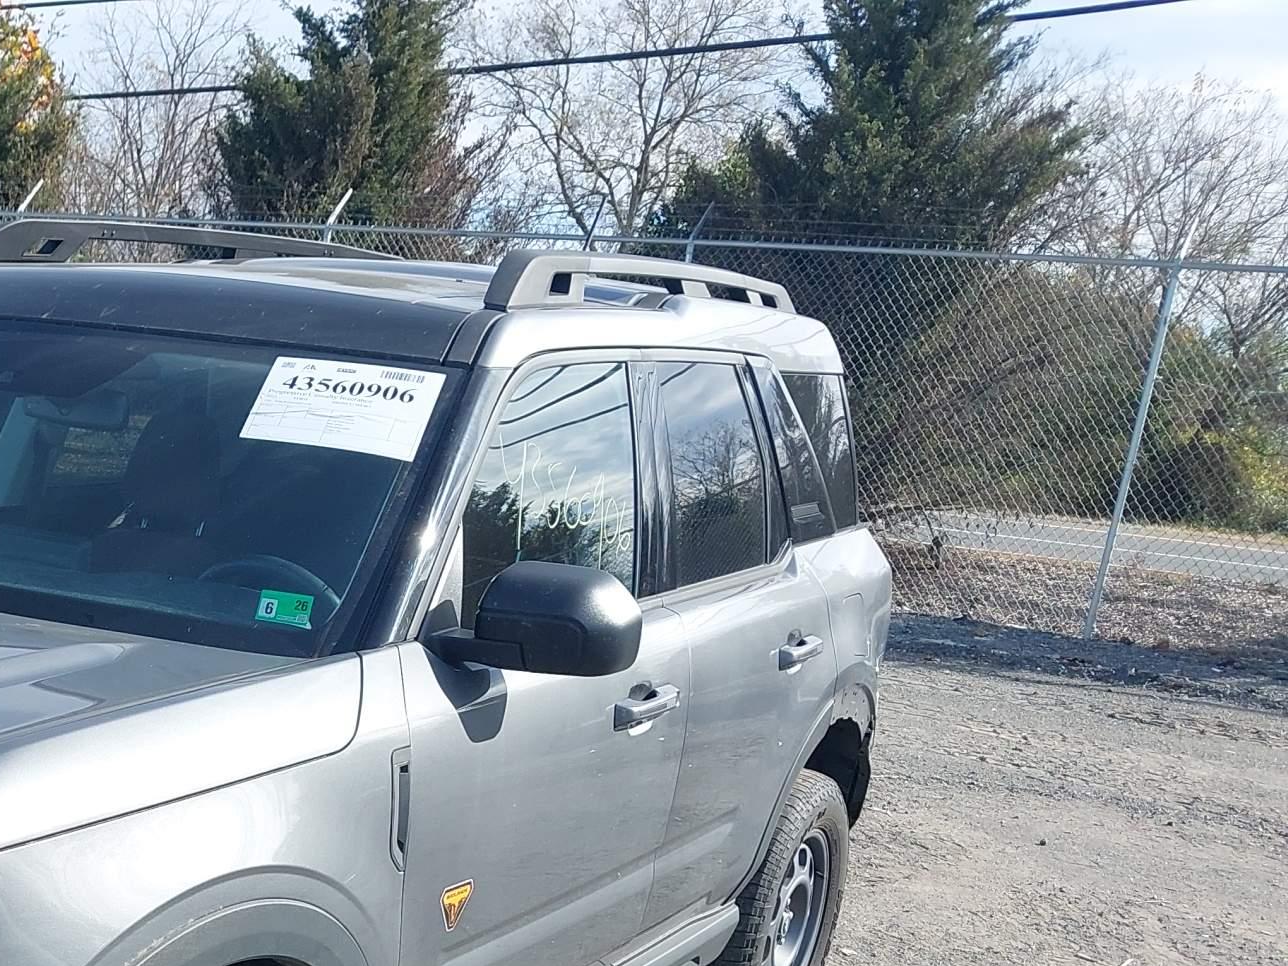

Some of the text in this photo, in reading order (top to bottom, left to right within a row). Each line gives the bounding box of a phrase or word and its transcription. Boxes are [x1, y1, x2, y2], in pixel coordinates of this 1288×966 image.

[282, 375, 417, 404] 43560906
[264, 601, 274, 615] 6
[295, 600, 308, 612] 26
